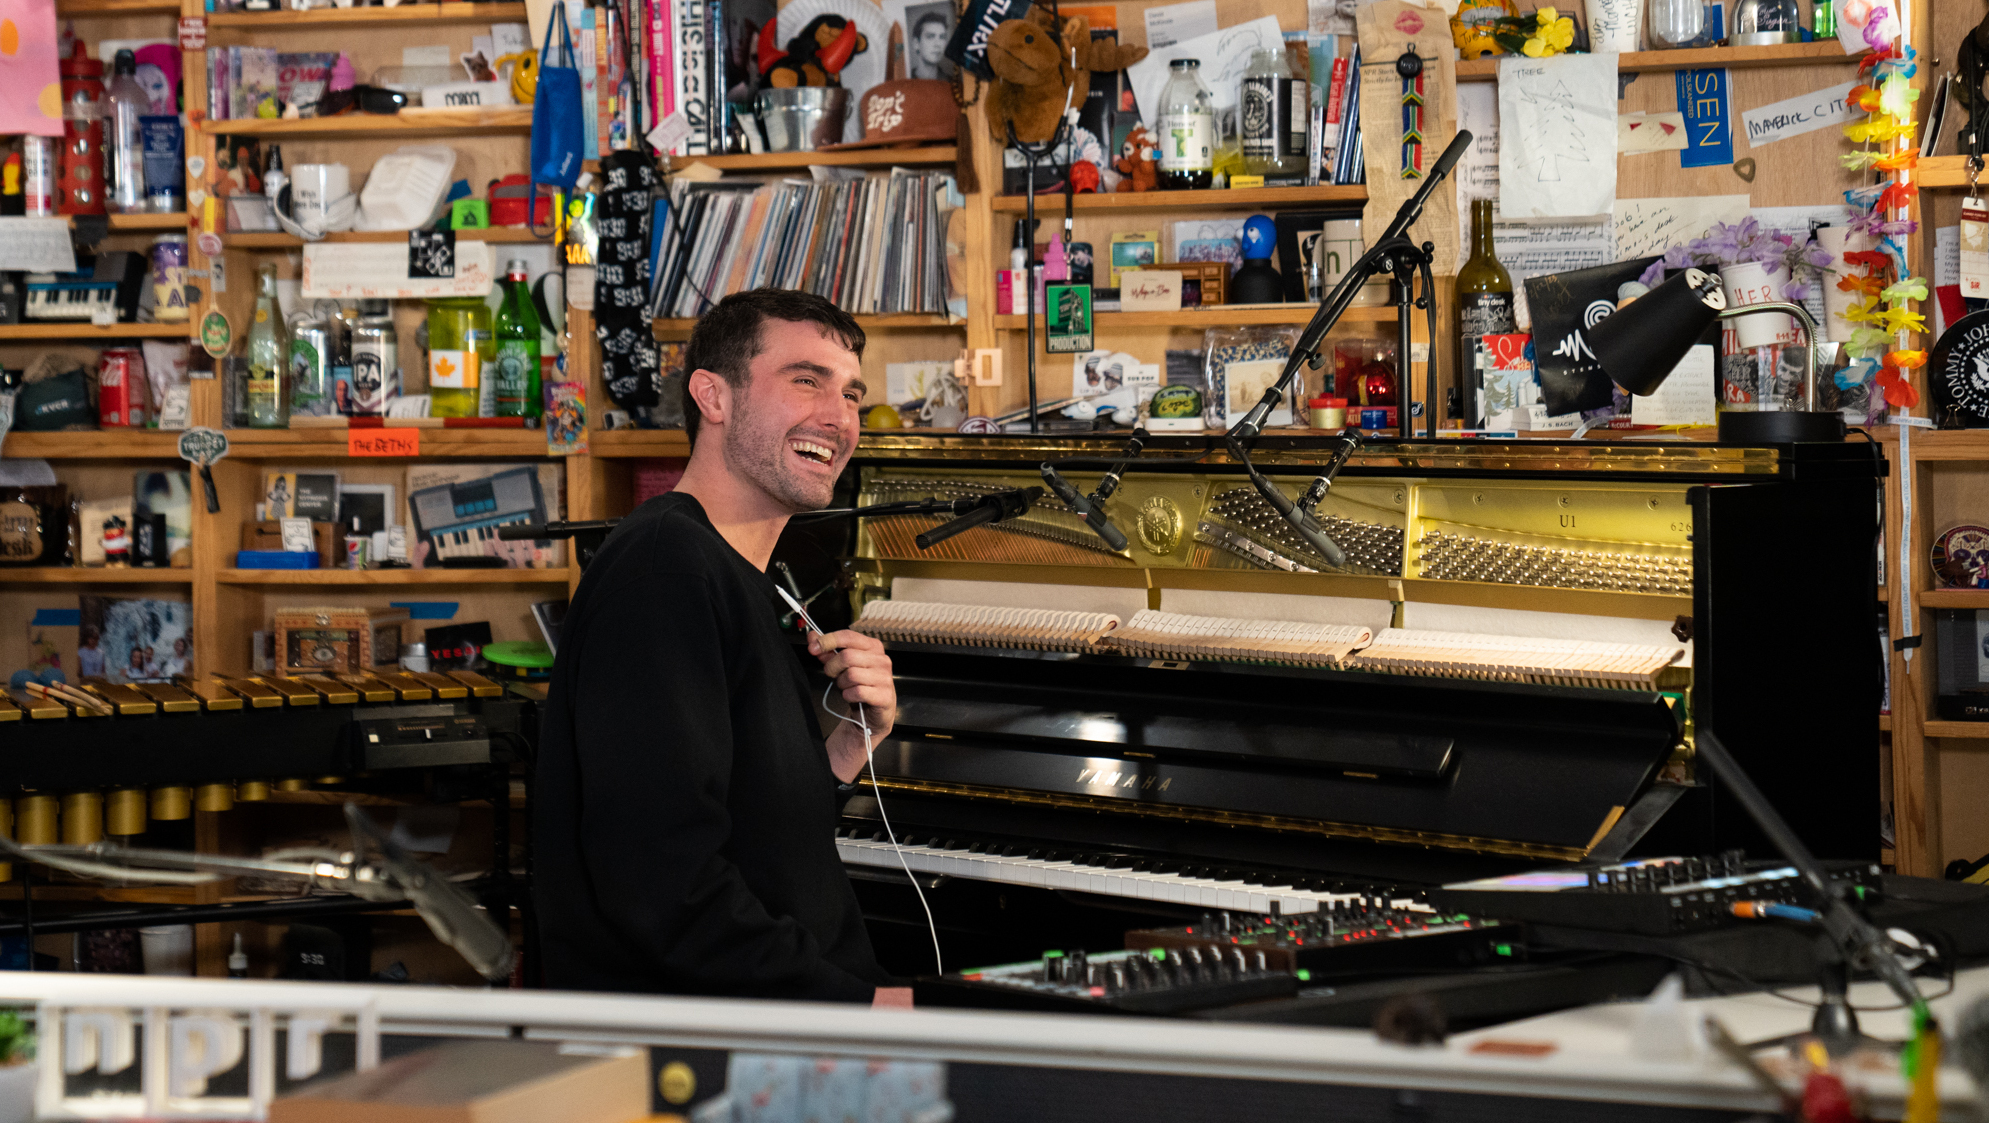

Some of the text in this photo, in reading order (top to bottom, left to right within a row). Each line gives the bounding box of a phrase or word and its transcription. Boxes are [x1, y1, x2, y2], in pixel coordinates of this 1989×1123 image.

[1512, 67, 1546, 79] TREE
[868, 90, 906, 113] Don't
[1694, 69, 1722, 147] SEN
[866, 111, 903, 133] Trip
[1167, 120, 1198, 129] Honest
[1749, 112, 1811, 139] MAVERICK
[1477, 297, 1506, 308] tiny desk
[1049, 335, 1092, 351] PRODUCTION
[353, 363, 381, 383] IPA
[1944, 347, 1972, 409] TOMMY
[1559, 514, 1576, 528] U1
[1075, 768, 1173, 792] YAMAHA
